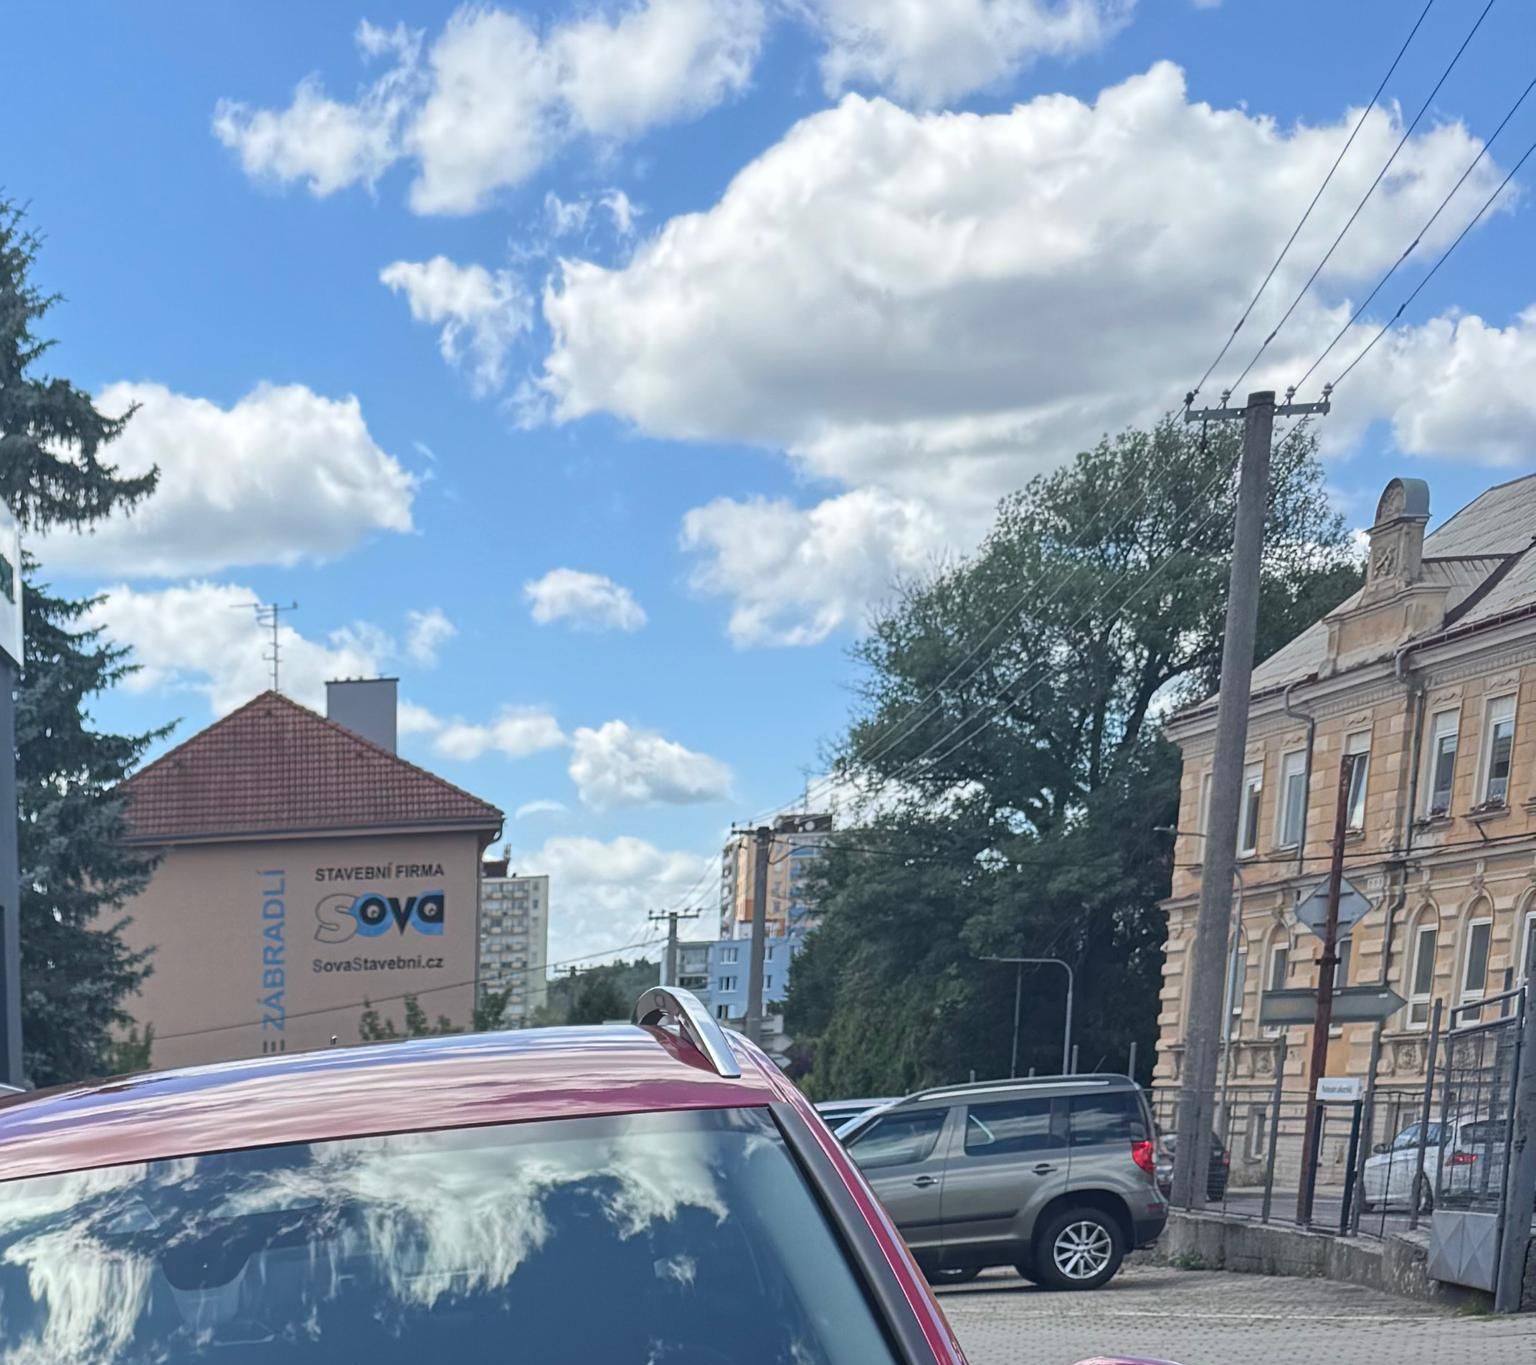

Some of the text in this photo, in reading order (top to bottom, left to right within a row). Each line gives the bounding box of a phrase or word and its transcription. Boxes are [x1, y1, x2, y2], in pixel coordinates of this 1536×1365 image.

[315, 862, 444, 882] STAVEBNÍ FIRMA
[257, 868, 286, 1032] ZÁBRADLÍ
